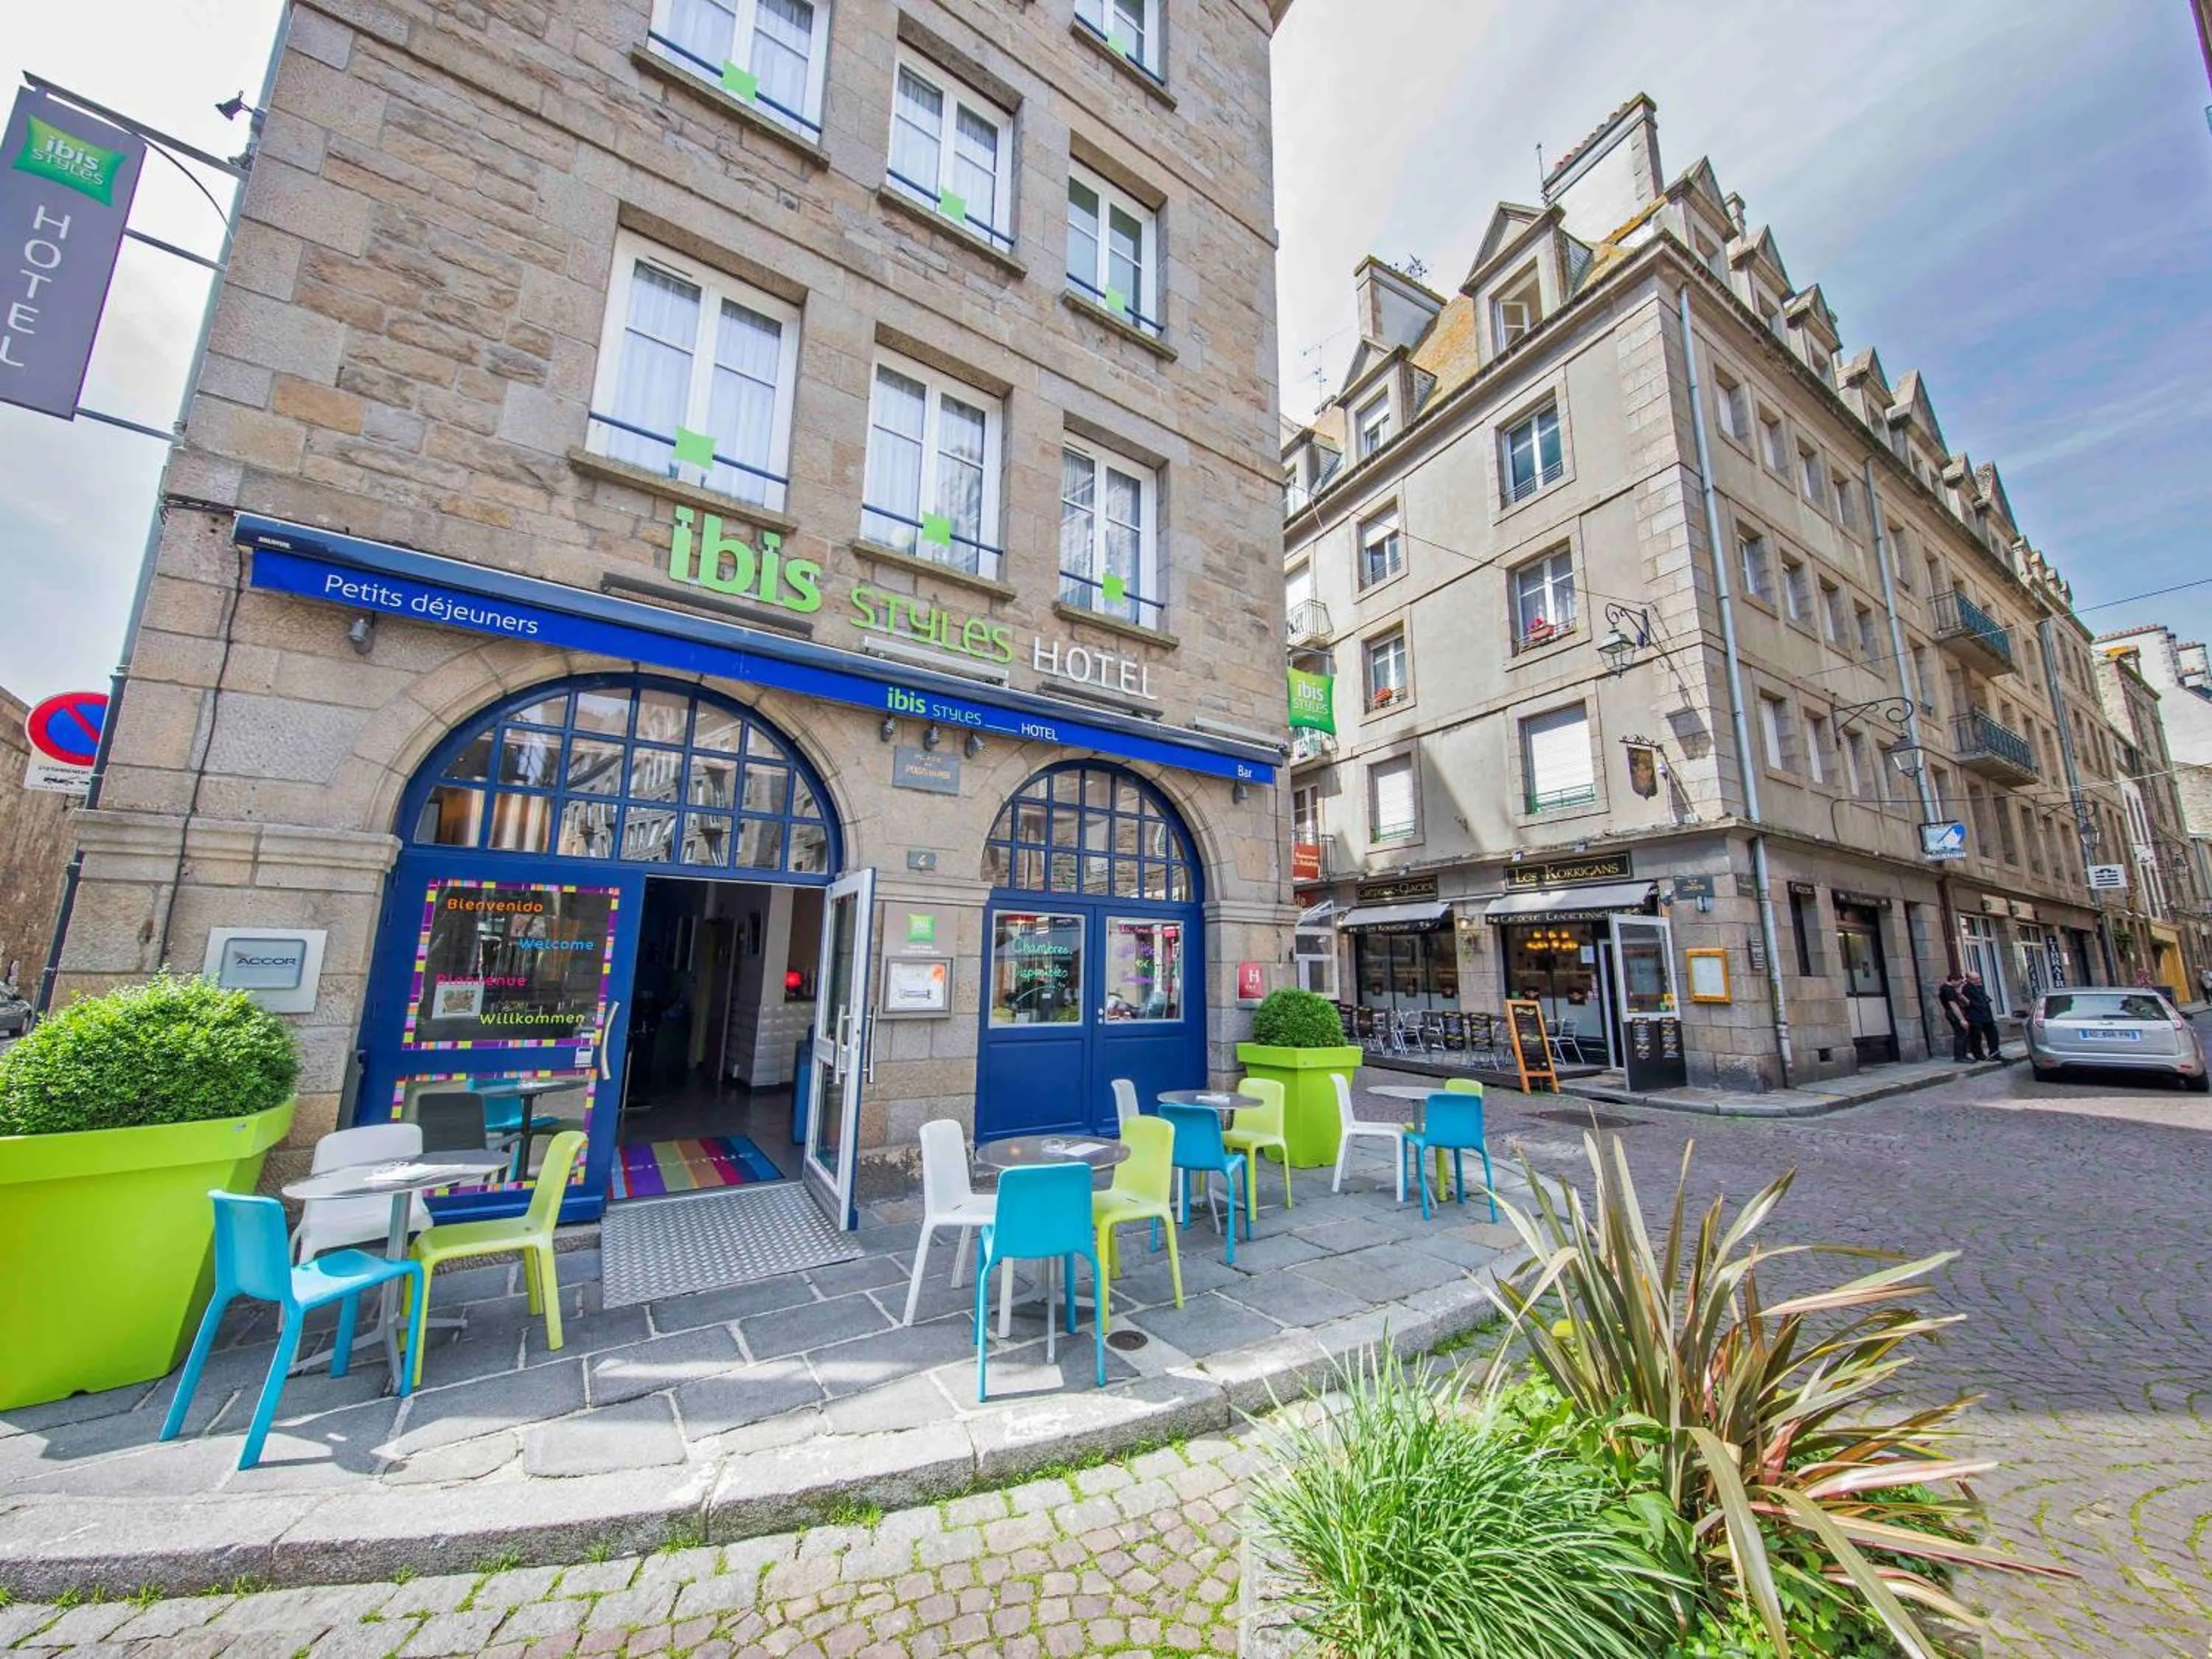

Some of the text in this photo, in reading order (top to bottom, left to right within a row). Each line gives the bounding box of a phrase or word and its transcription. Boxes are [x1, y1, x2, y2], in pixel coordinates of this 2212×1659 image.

[46, 136, 99, 170] ibis
[0, 205, 71, 367] HOTEL
[324, 574, 538, 634] Petits déjeuners
[669, 505, 822, 613] ibis
[1033, 636, 1158, 700] HOTEL
[1298, 680, 1324, 701] ibis
[887, 686, 926, 714] ibis
[1021, 723, 1059, 741] HOTEL
[1238, 765, 1252, 778] Bar
[447, 898, 543, 913] Bienvenido
[519, 937, 594, 951] Welcome
[236, 957, 296, 965] ACCOR
[2047, 937, 2065, 988] LIBRAIR
[480, 1012, 585, 1026] Willkommen
